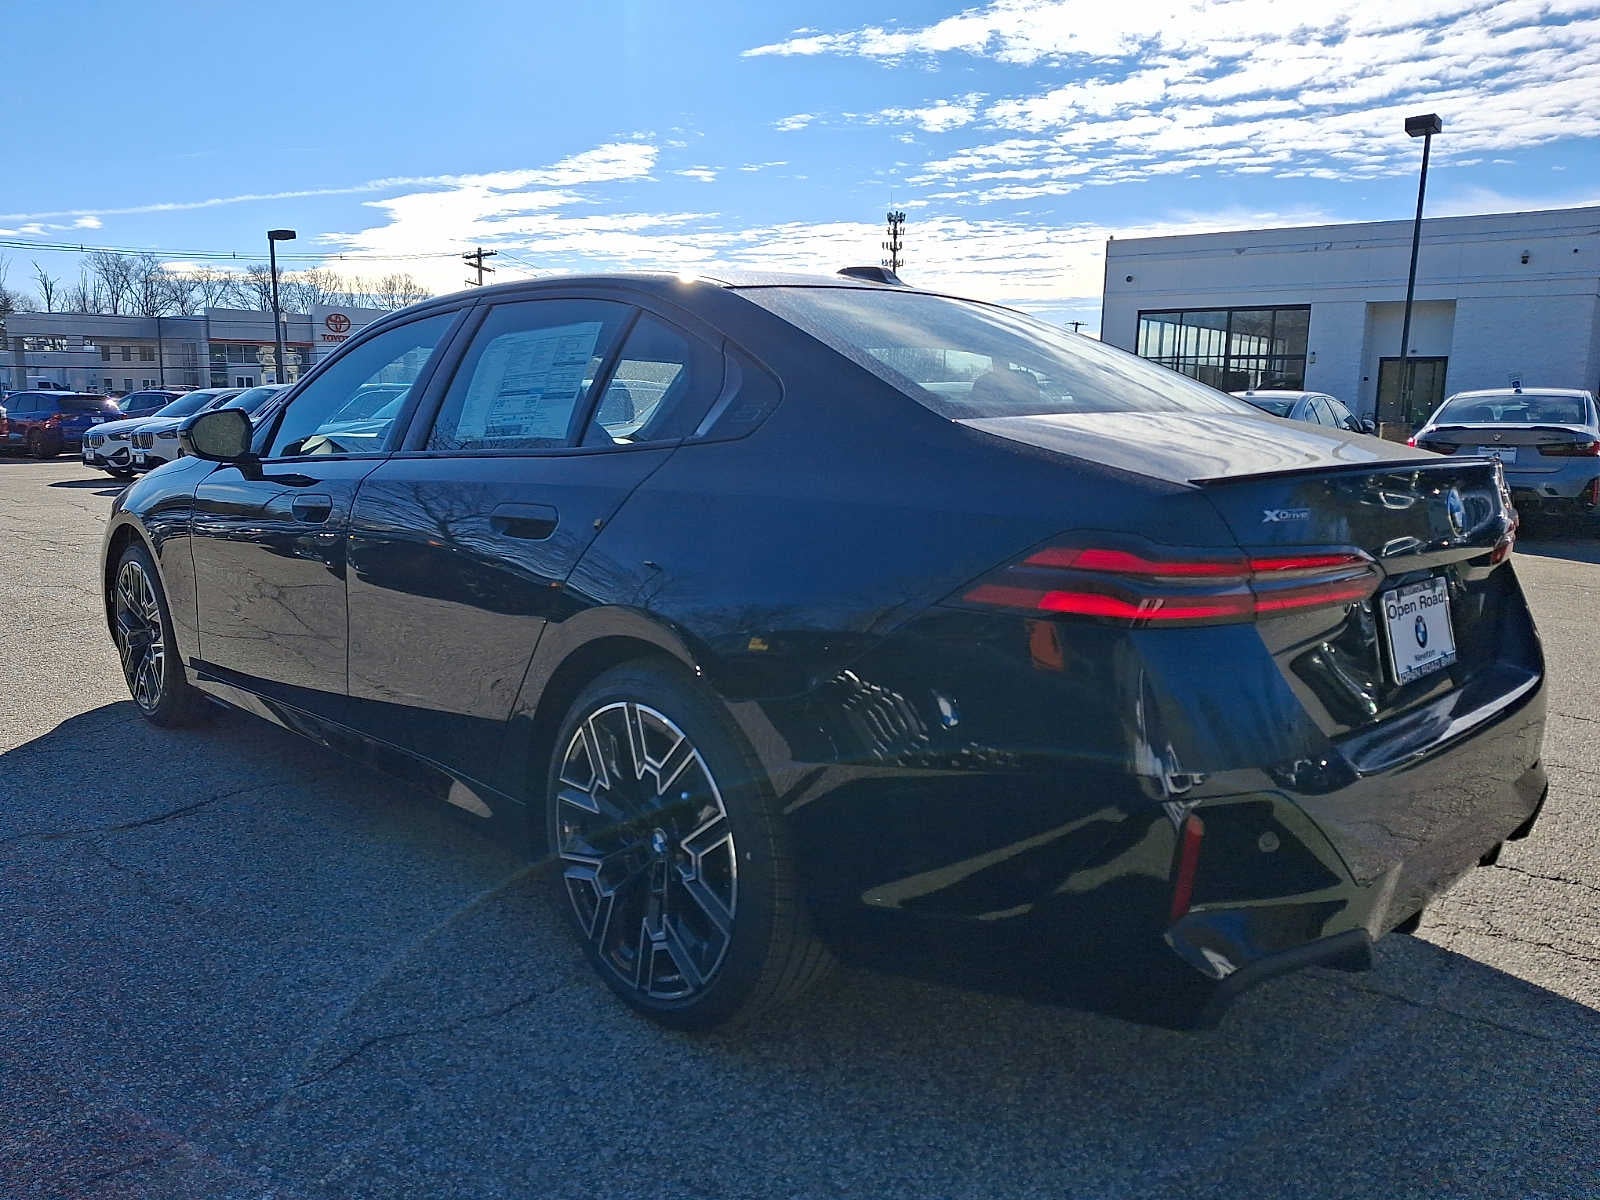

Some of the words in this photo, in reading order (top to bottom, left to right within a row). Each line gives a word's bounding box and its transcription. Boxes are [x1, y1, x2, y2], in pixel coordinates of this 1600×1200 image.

[321, 334, 351, 343] TOYOT
[1387, 602, 1417, 620] Open
[1419, 591, 1444, 609] Road
